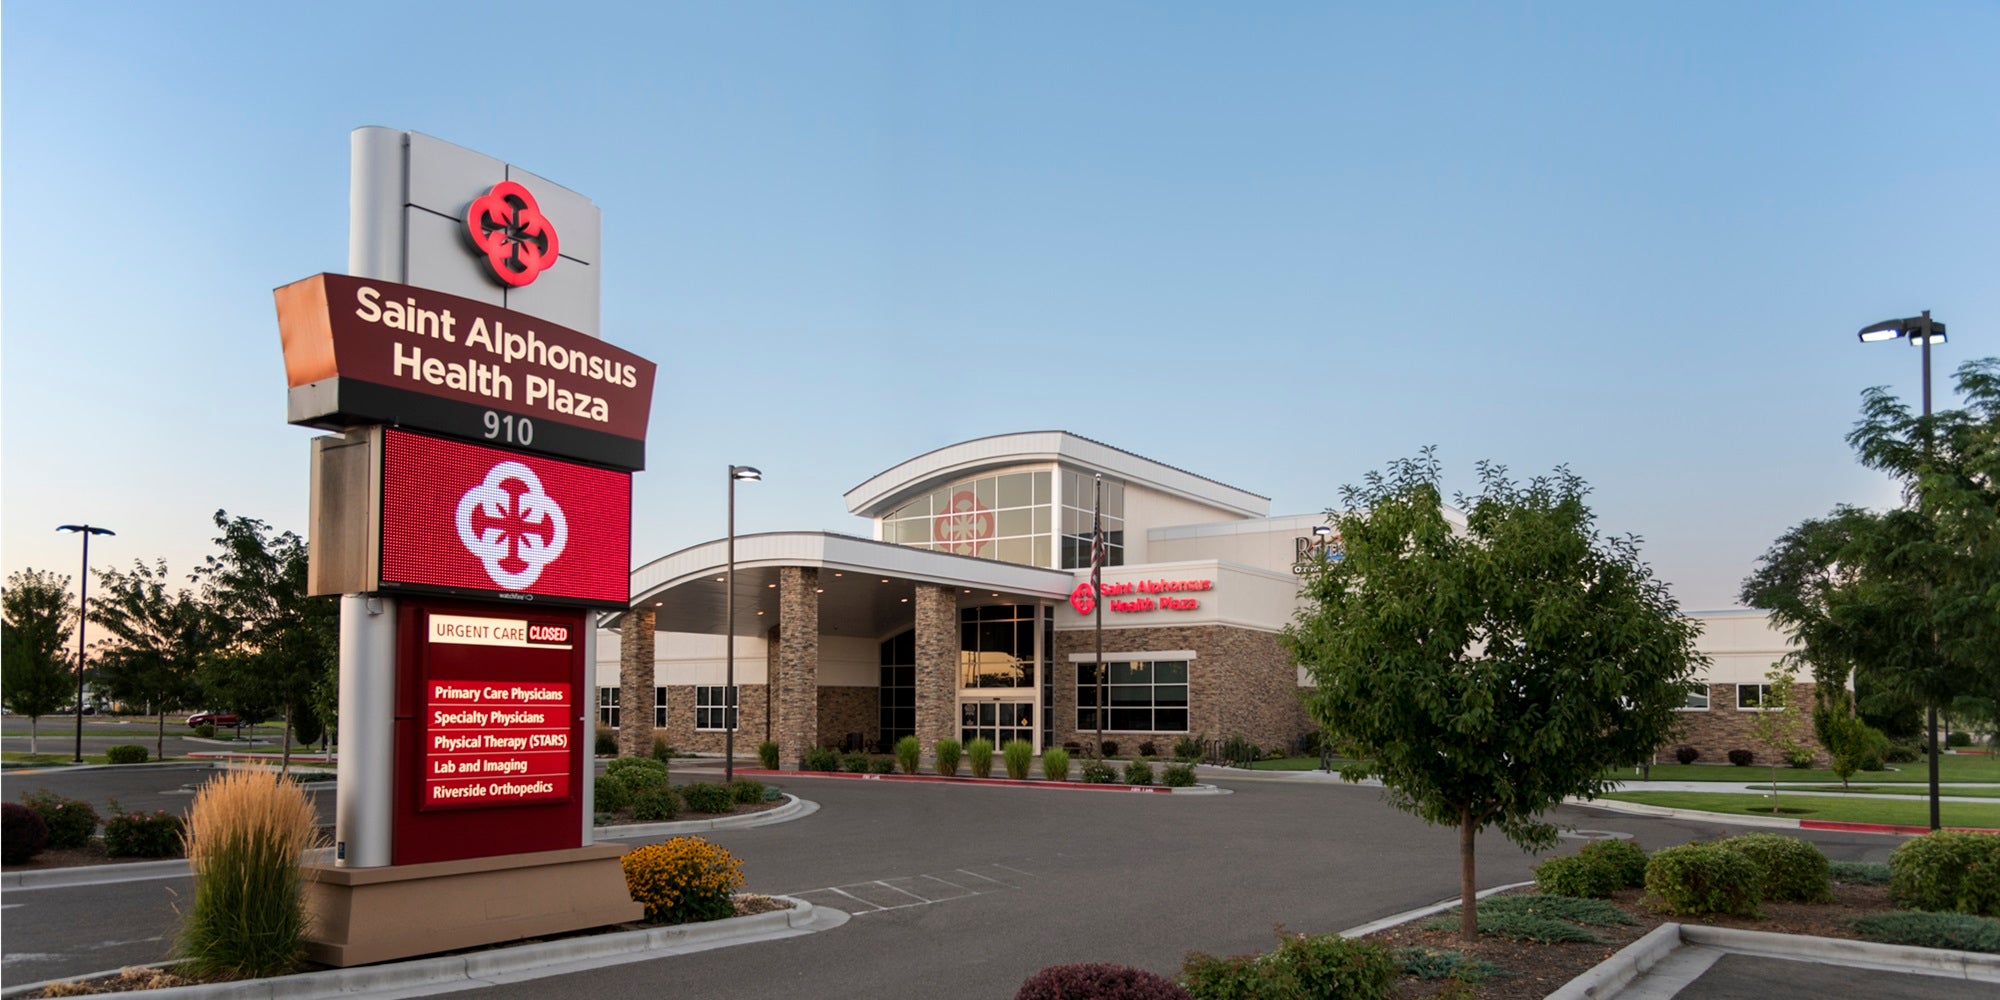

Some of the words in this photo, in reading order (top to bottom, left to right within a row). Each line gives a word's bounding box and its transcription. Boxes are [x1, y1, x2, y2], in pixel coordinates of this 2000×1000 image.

[356, 286, 456, 342] Saint
[465, 317, 637, 388] Alphonsus
[393, 342, 513, 401] Health
[526, 375, 609, 423] Plaza
[483, 410, 534, 447] 910
[1100, 582, 1132, 596] Saint
[1136, 579, 1211, 595] Alphonsus
[1110, 598, 1154, 612] Health
[1159, 596, 1198, 610] Plaza
[436, 623, 489, 639] URGENT
[493, 627, 525, 641] CARE
[529, 625, 568, 642] CLOSED
[435, 686, 480, 702] Primary
[483, 687, 509, 700] Care
[511, 688, 563, 702] Physicians
[434, 711, 488, 729] Specialty
[490, 711, 545, 727] Physicians
[434, 735, 482, 752] Physical
[484, 736, 527, 751] Therapy
[529, 734, 568, 749] (STARS)
[434, 761, 456, 774] Lab
[459, 759, 481, 773] and
[483, 759, 528, 774] Imaging
[433, 785, 487, 799] Riverside
[489, 780, 553, 796] Orthopedics
